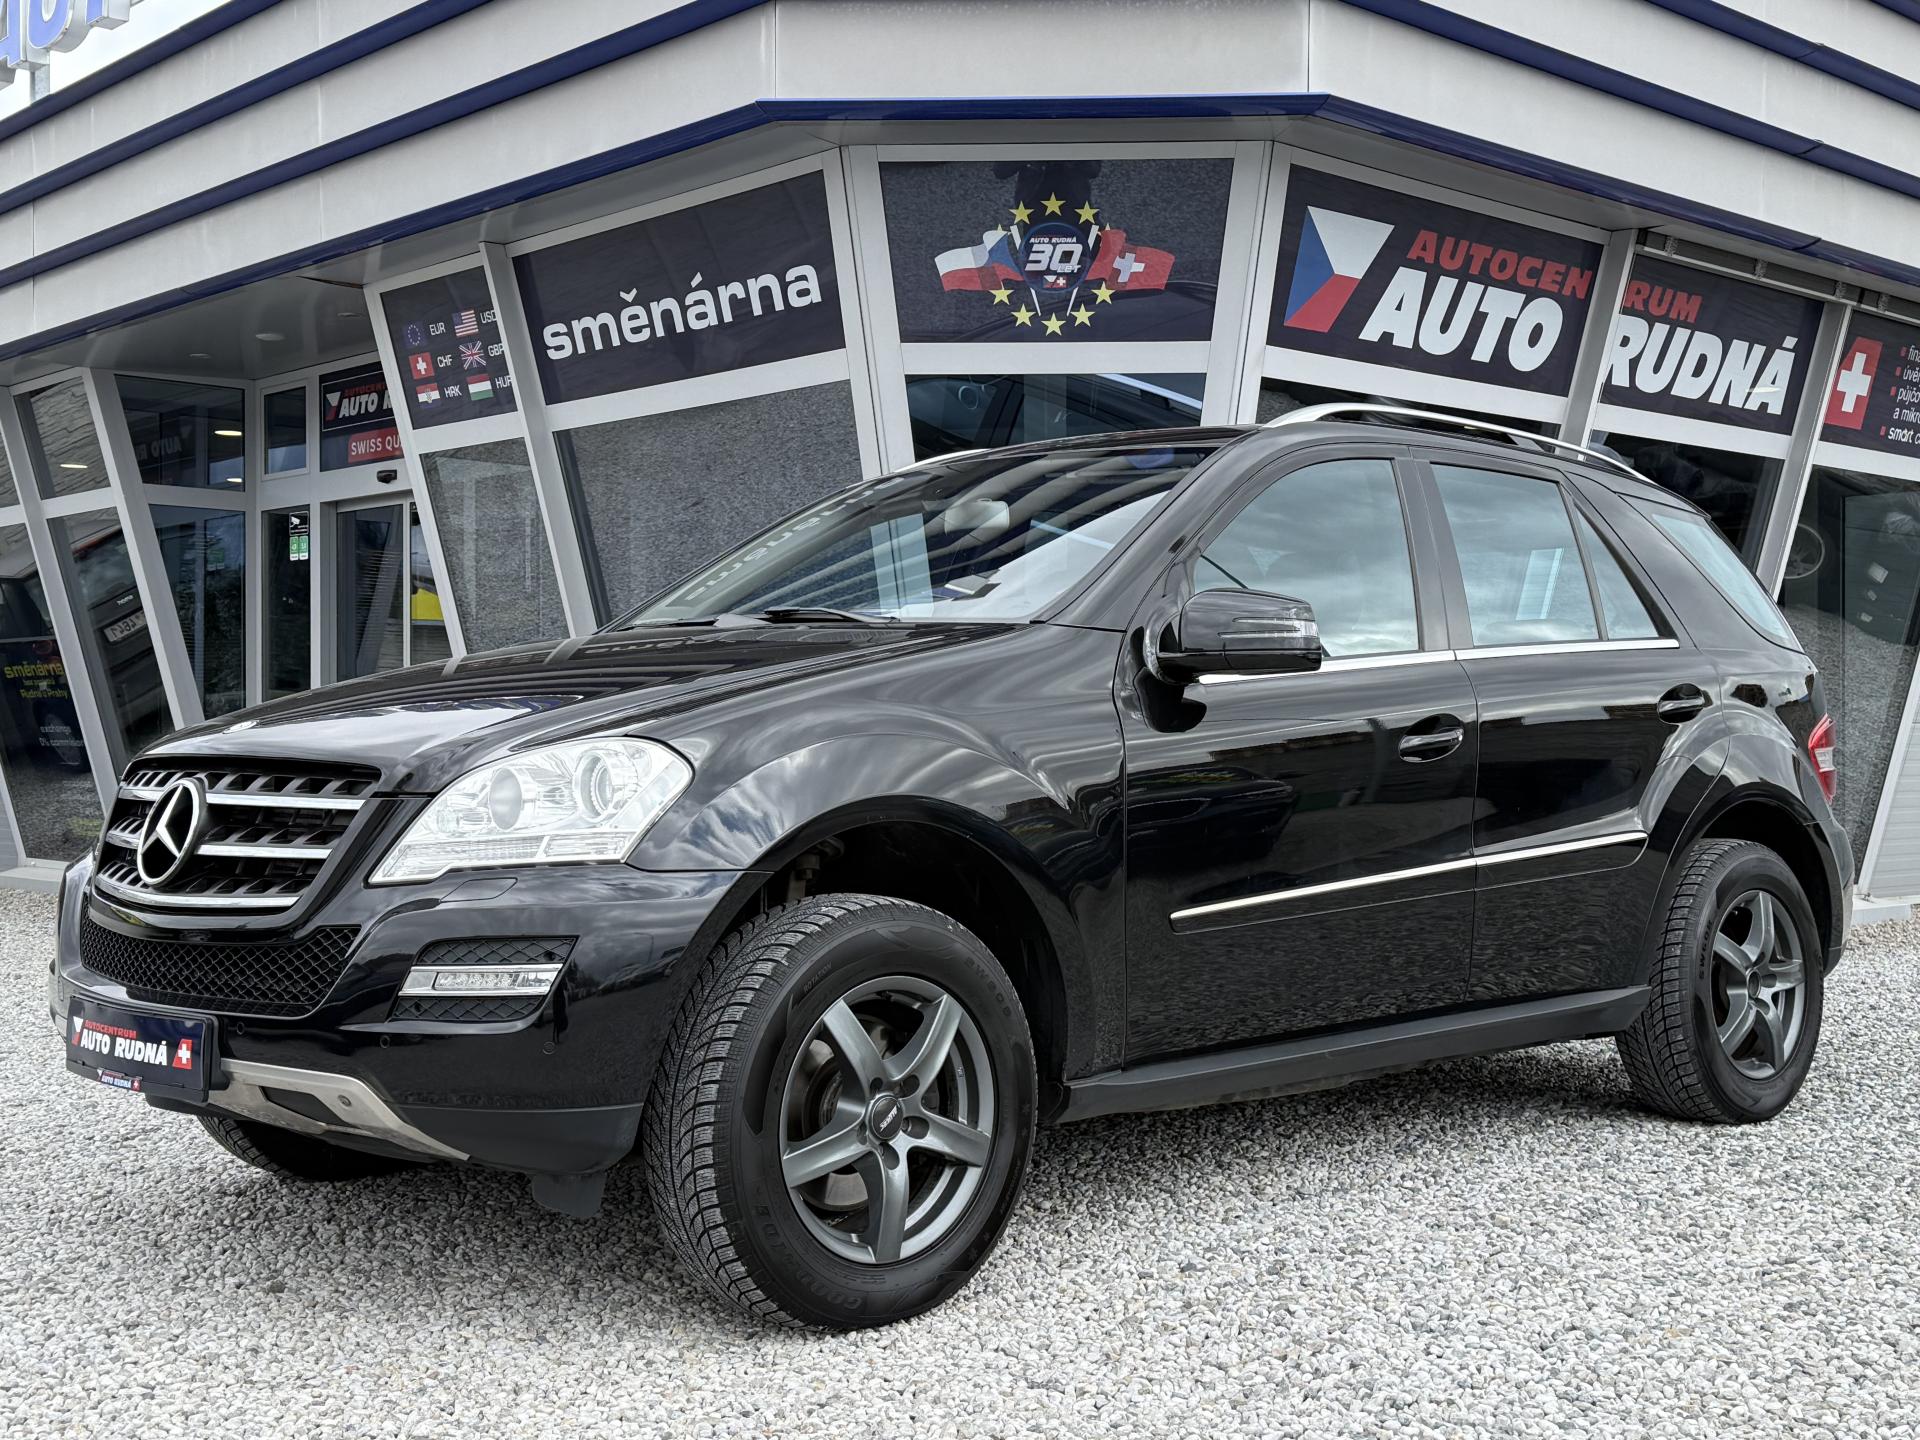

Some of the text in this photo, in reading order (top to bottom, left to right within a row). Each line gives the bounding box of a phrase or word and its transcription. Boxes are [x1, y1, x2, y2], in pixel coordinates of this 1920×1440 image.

[1051, 236, 1077, 244] RUDNÁ
[1025, 243, 1083, 271] 30
[1057, 264, 1081, 273] LET
[480, 310, 497, 324] USD
[543, 264, 822, 360] směnárna
[429, 322, 446, 335] EUR
[1358, 266, 1798, 416] AUTO RUDNÁ
[488, 343, 504, 357] GBP
[437, 354, 453, 367] CHF
[444, 385, 462, 398] HRK
[338, 392, 379, 418] AUTO
[1893, 407, 1899, 419] a
[1888, 427, 1914, 444] smart
[351, 434, 402, 455] SWISS QU
[4, 660, 65, 679] směnárna
[84, 1019, 136, 1038] AUTOCENTRUM
[80, 1029, 167, 1066] AUTO RUDNÁ
